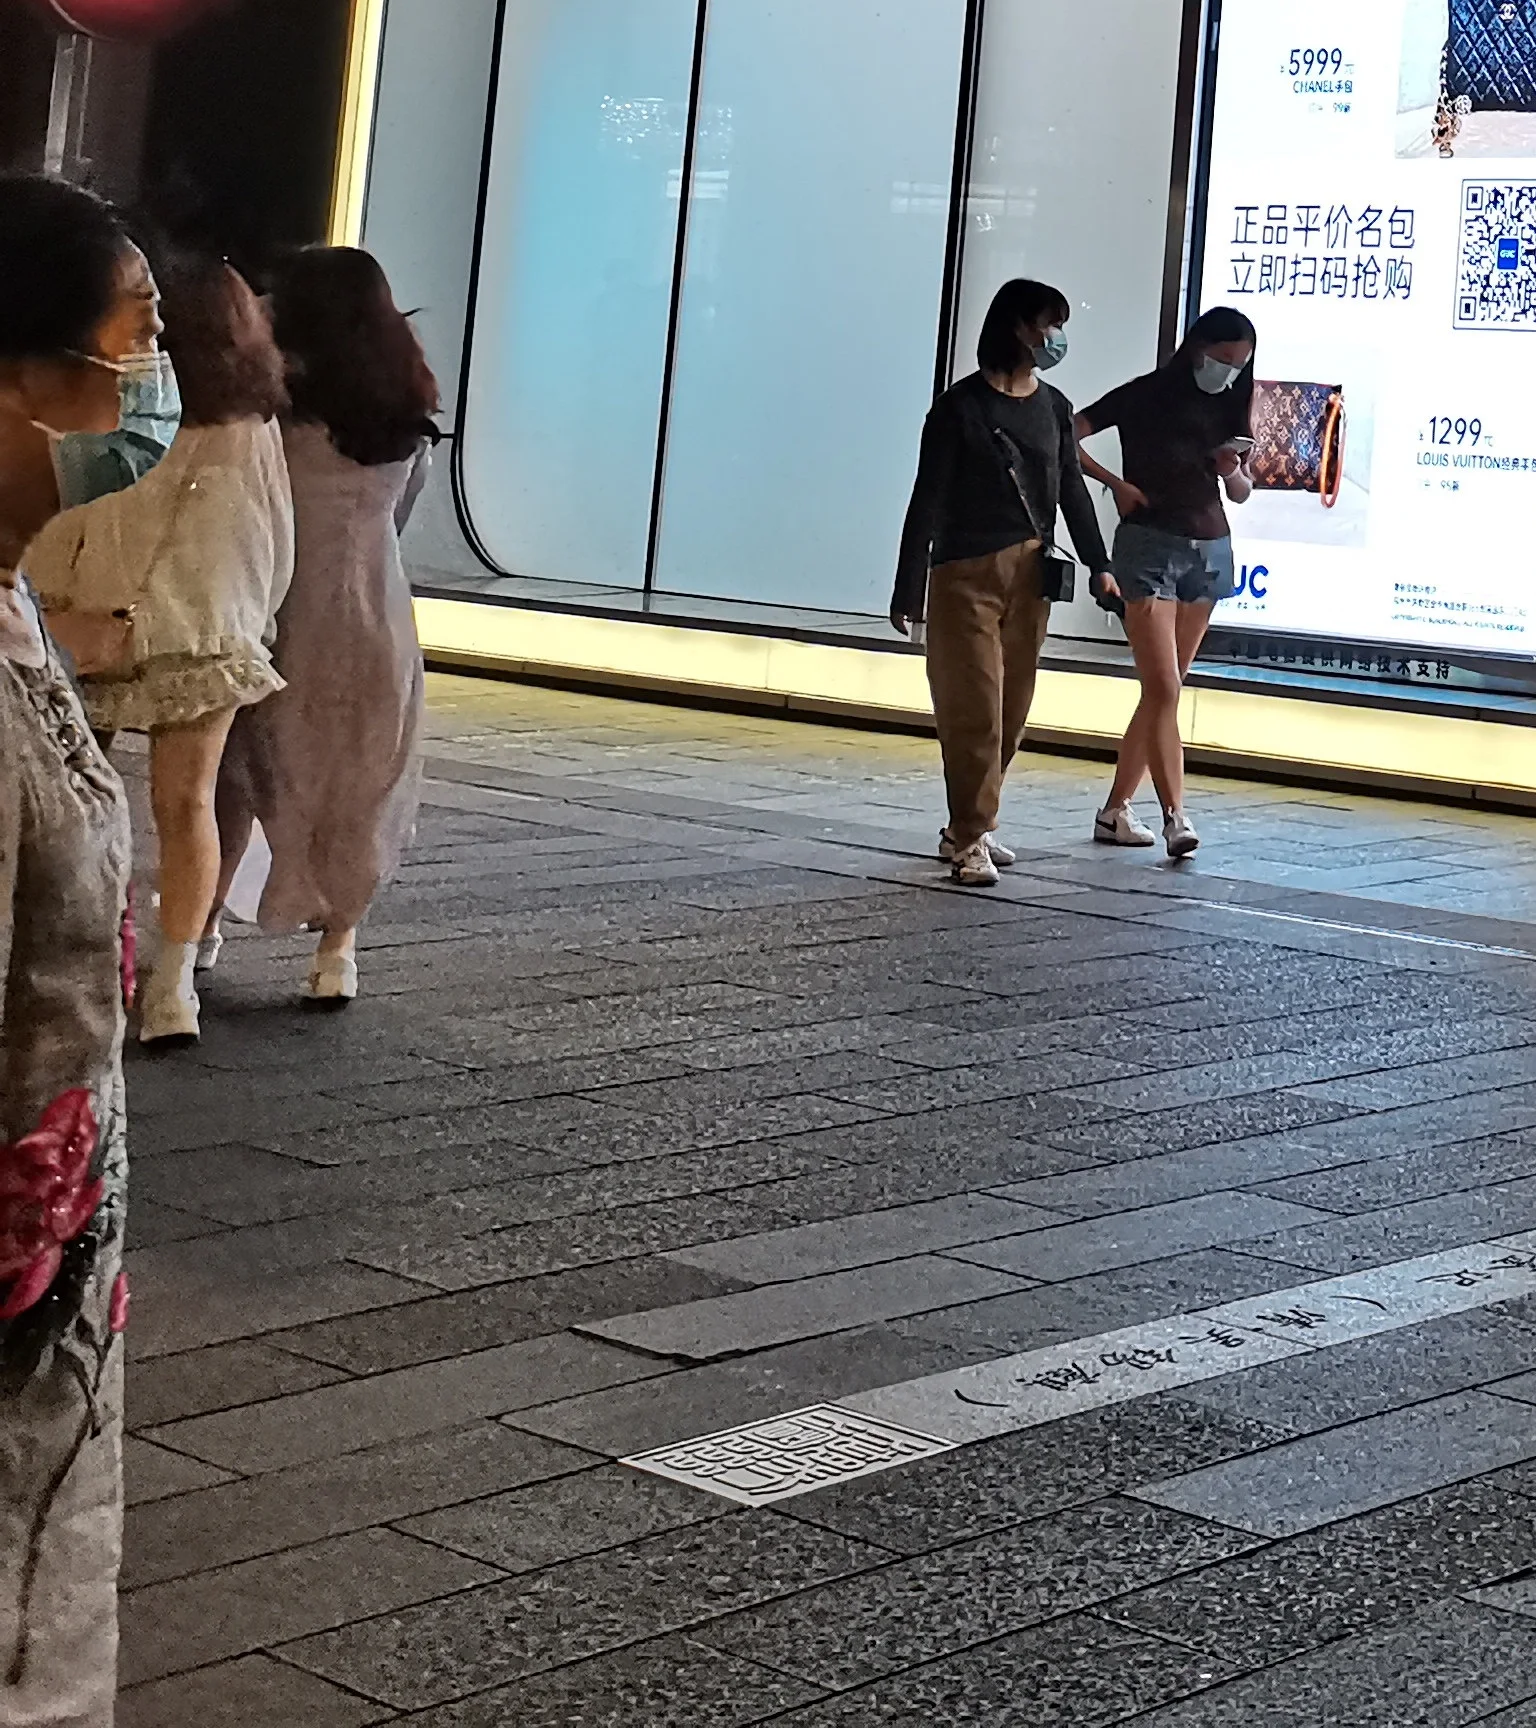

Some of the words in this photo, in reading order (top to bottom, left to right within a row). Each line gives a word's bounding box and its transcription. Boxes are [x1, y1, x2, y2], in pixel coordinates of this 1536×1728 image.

[1231, 204, 1416, 249] 正品平价名包
[1227, 253, 1413, 300] 立即扫码抢购
[1417, 452, 1449, 468] LOUIS
